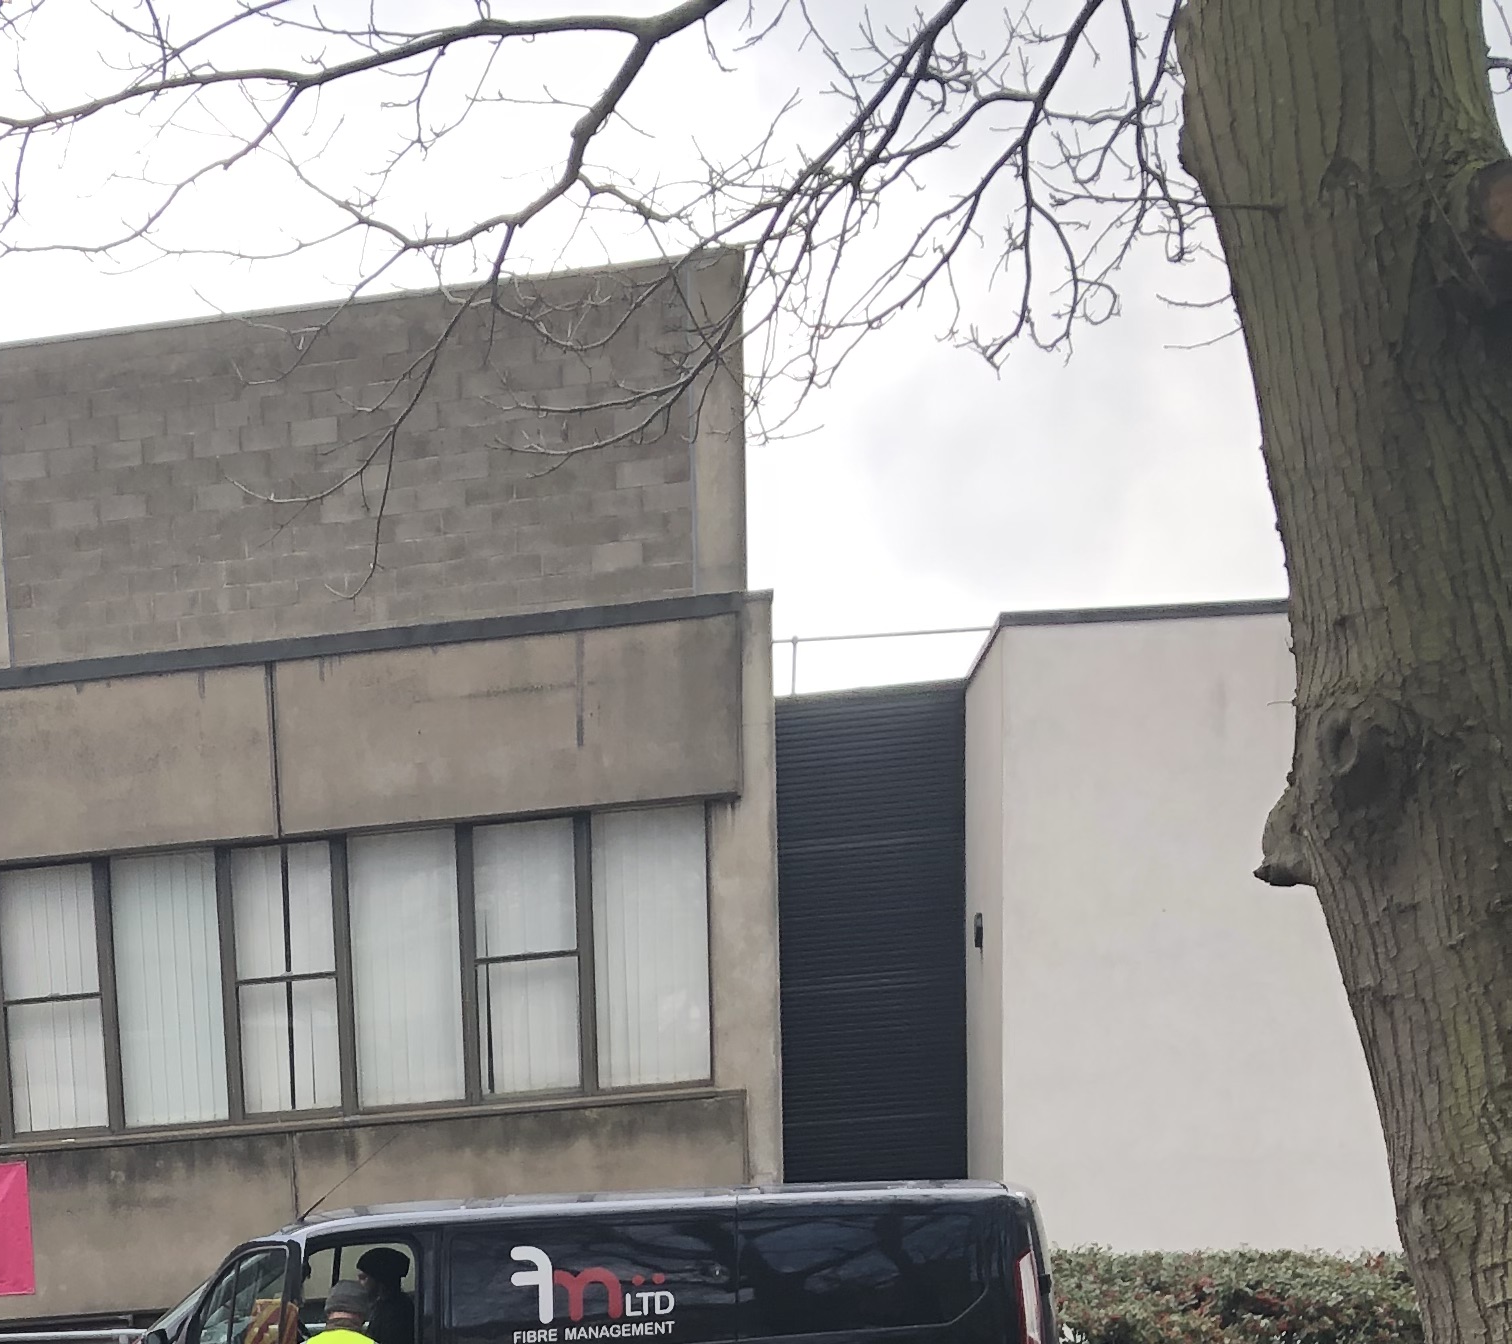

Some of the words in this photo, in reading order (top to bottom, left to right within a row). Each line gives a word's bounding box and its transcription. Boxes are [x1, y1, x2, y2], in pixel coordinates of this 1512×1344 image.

[625, 1290, 675, 1317] LTD
[513, 1328, 558, 1344] FIBRE
[564, 1320, 676, 1341] MANAGEMENT
